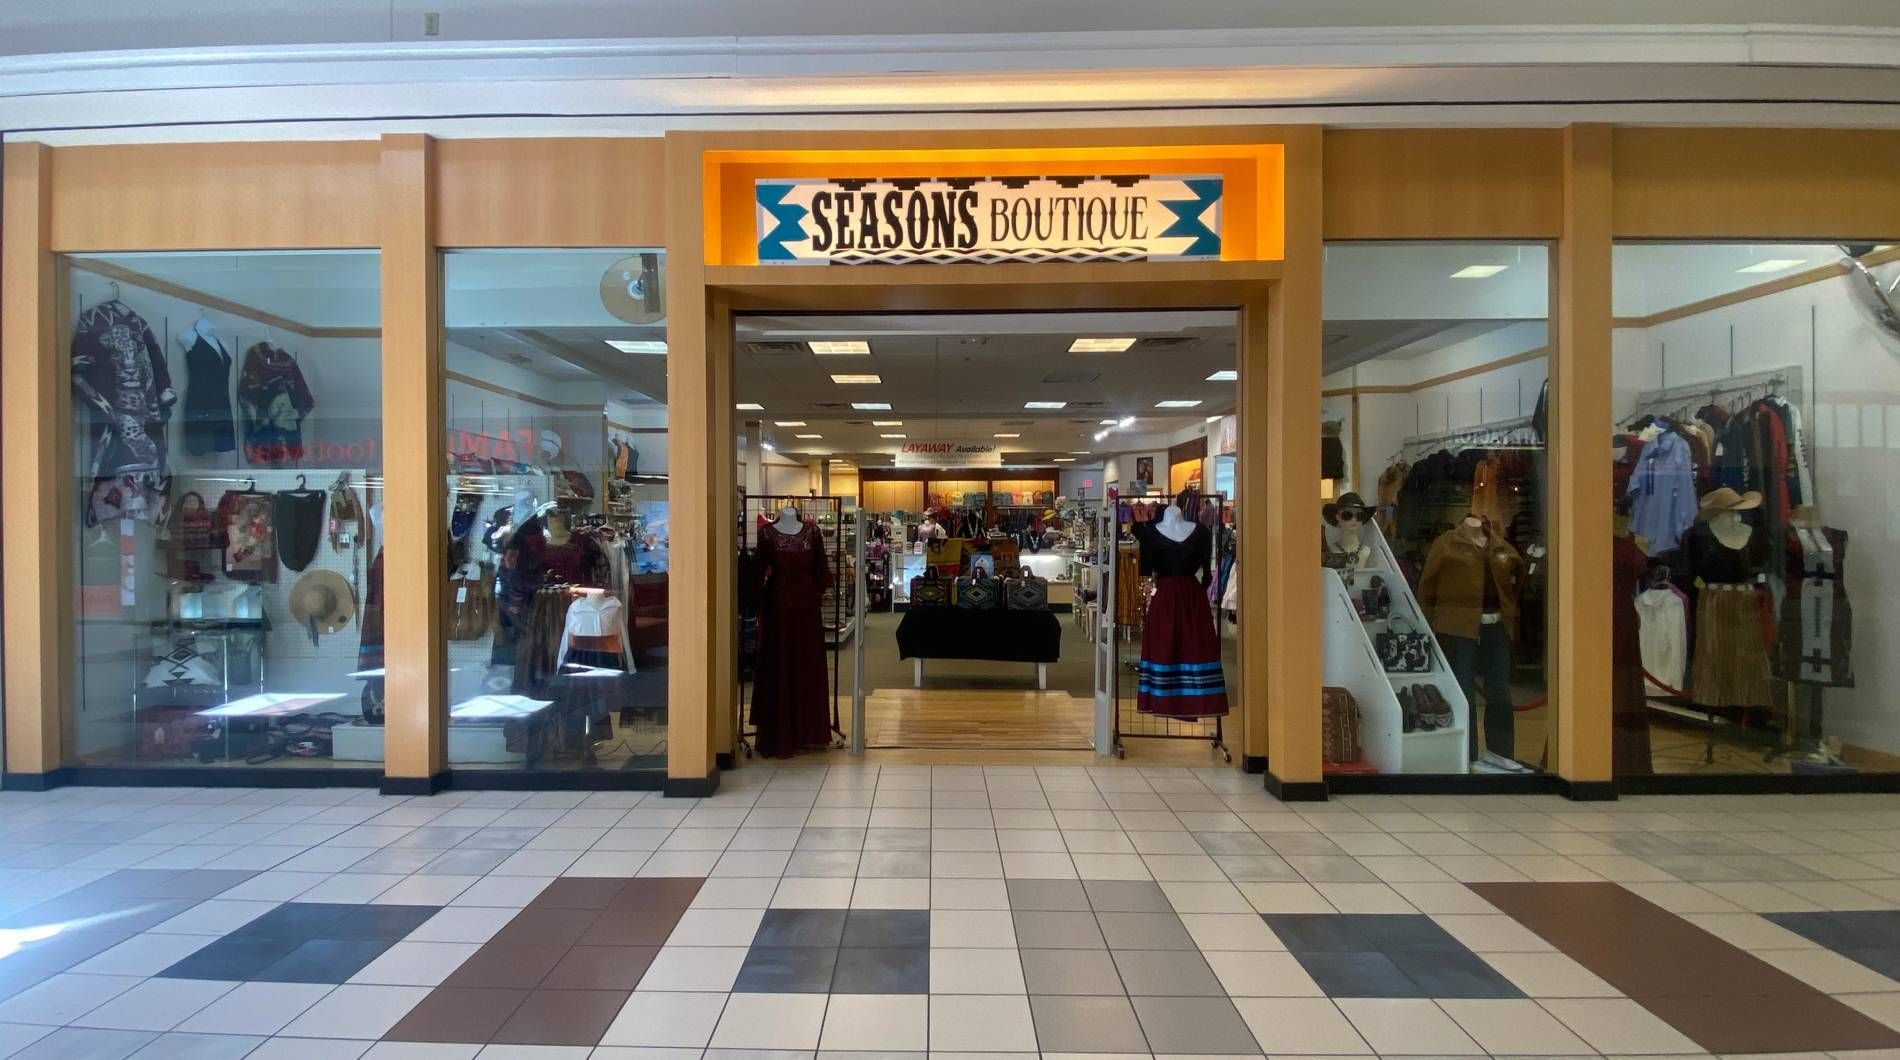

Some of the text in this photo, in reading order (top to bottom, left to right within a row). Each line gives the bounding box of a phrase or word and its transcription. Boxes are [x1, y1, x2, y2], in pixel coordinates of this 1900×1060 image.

[811, 190, 1148, 252] SEASONS BOUTIQUE
[901, 442, 996, 454] LAYAWAY Available!
